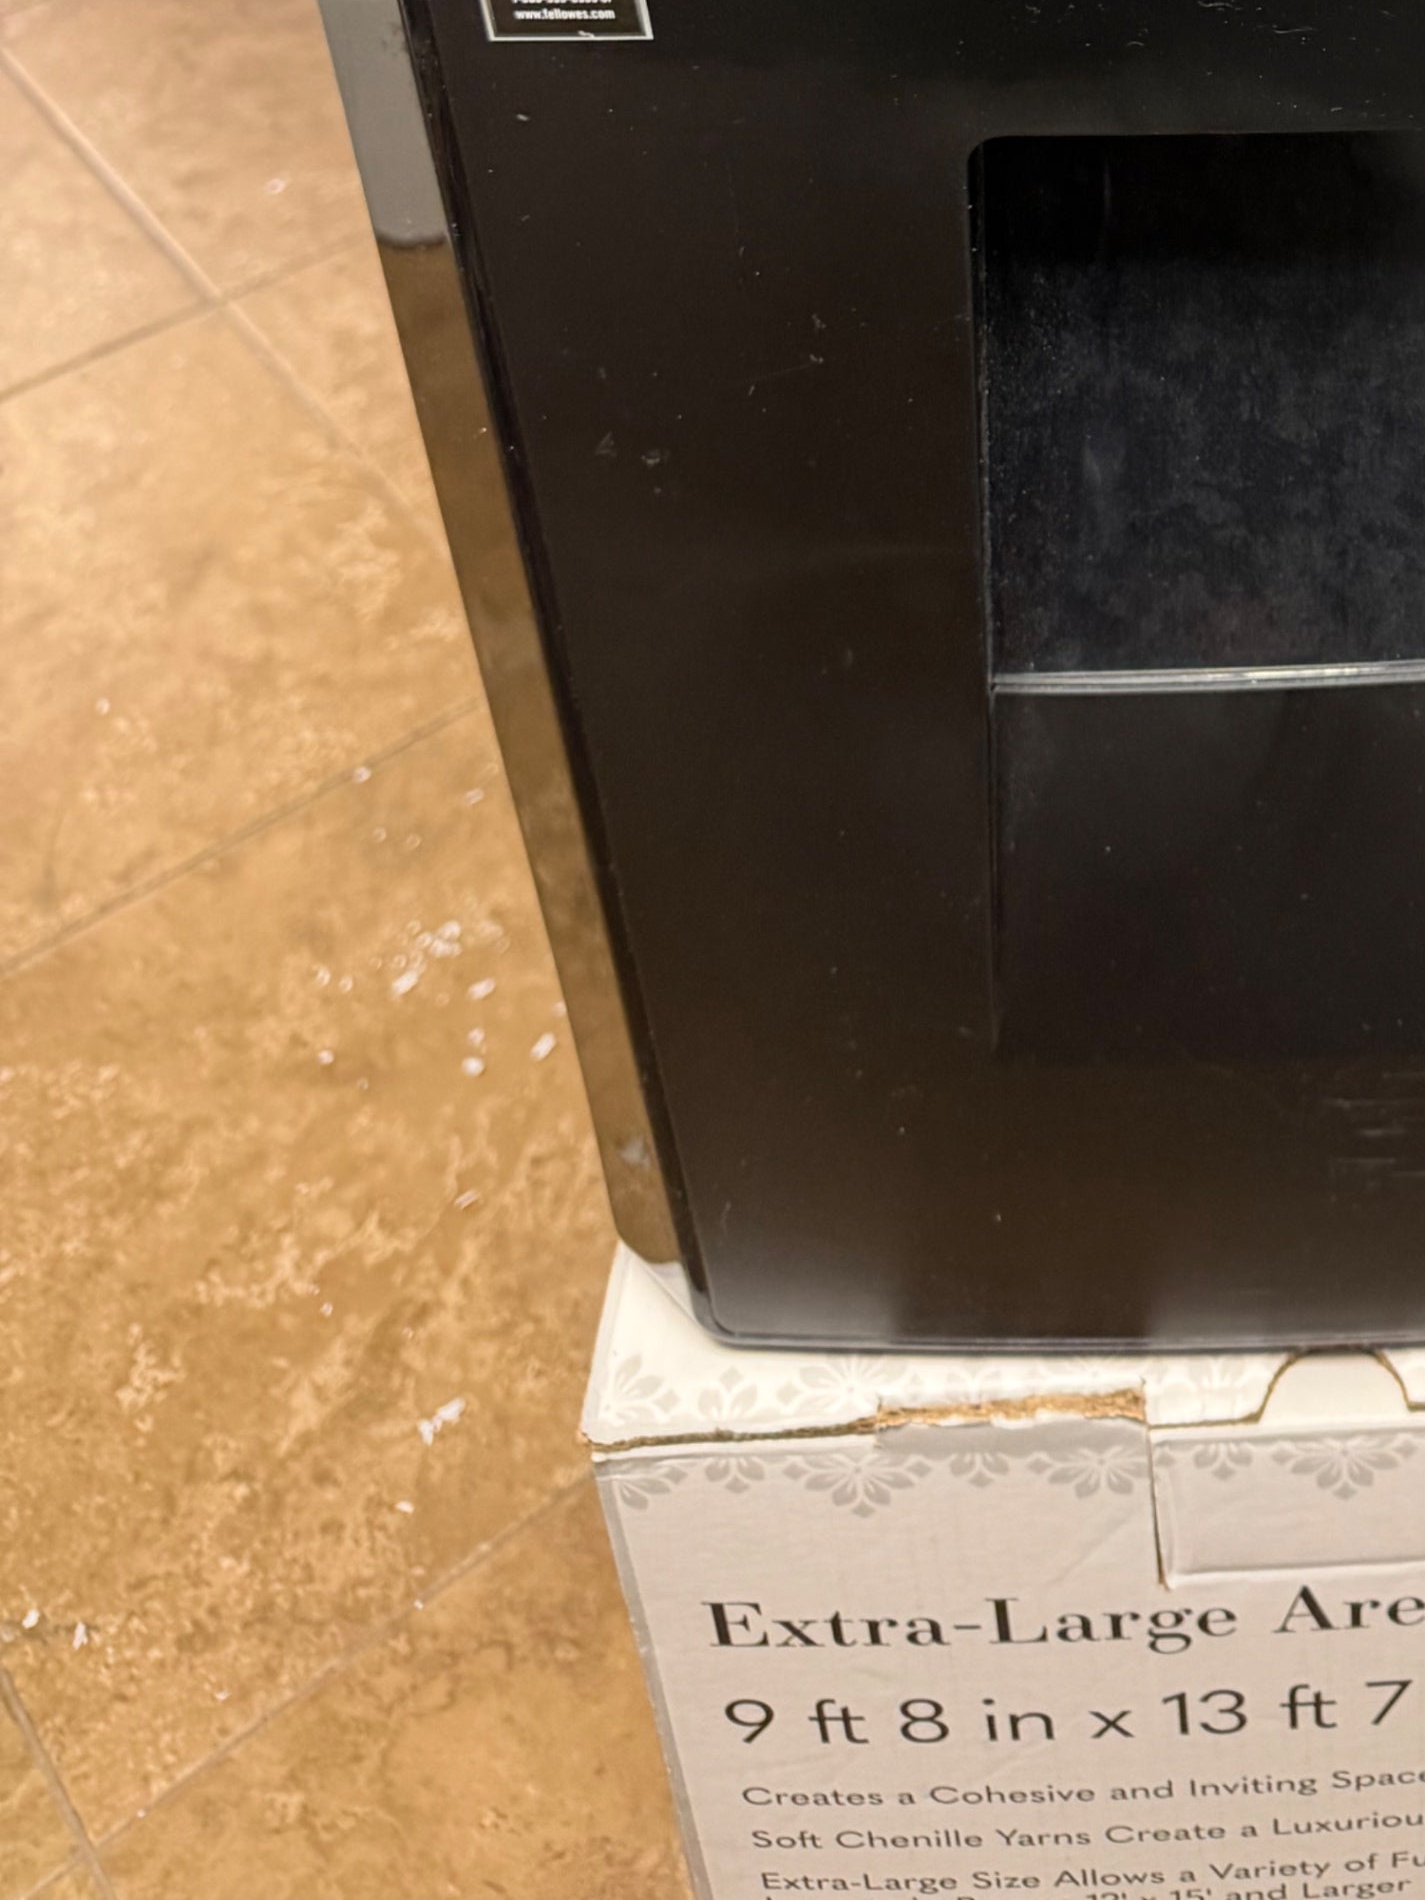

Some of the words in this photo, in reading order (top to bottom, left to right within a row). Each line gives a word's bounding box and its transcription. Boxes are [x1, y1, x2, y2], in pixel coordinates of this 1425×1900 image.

[514, 8, 616, 20] www.fellowes.com
[701, 1597, 1237, 1655] Extra-Large
[724, 1699, 775, 1744] 9
[808, 1699, 869, 1745] ft
[899, 1698, 950, 1744] 8
[981, 1697, 1055, 1742] in
[1089, 1709, 1135, 1740] x
[1163, 1689, 1248, 1736] 13
[1279, 1683, 1338, 1730] ft
[1364, 1678, 1413, 1726] 7
[742, 1786, 883, 1806] Creates
[899, 1790, 916, 1805] a
[930, 1784, 1095, 1805] Cohesive
[1111, 1780, 1174, 1800] and
[1190, 1775, 1317, 1797] Inviting
[751, 1830, 823, 1850] Soft
[836, 1829, 983, 1849] Chenille
[996, 1828, 1091, 1847] Yarns
[1105, 1824, 1226, 1843] Create
[1240, 1823, 1258, 1838] a
[760, 1872, 957, 1895] Extra-Large
[972, 1869, 1041, 1890] Size
[1053, 1868, 1165, 1888] Allows
[1179, 1868, 1196, 1883] a
[1209, 1858, 1331, 1882] Variety
[1345, 1853, 1379, 1873] of
[1224, 1882, 1287, 1900] and
[1302, 1877, 1412, 1898] Larger
